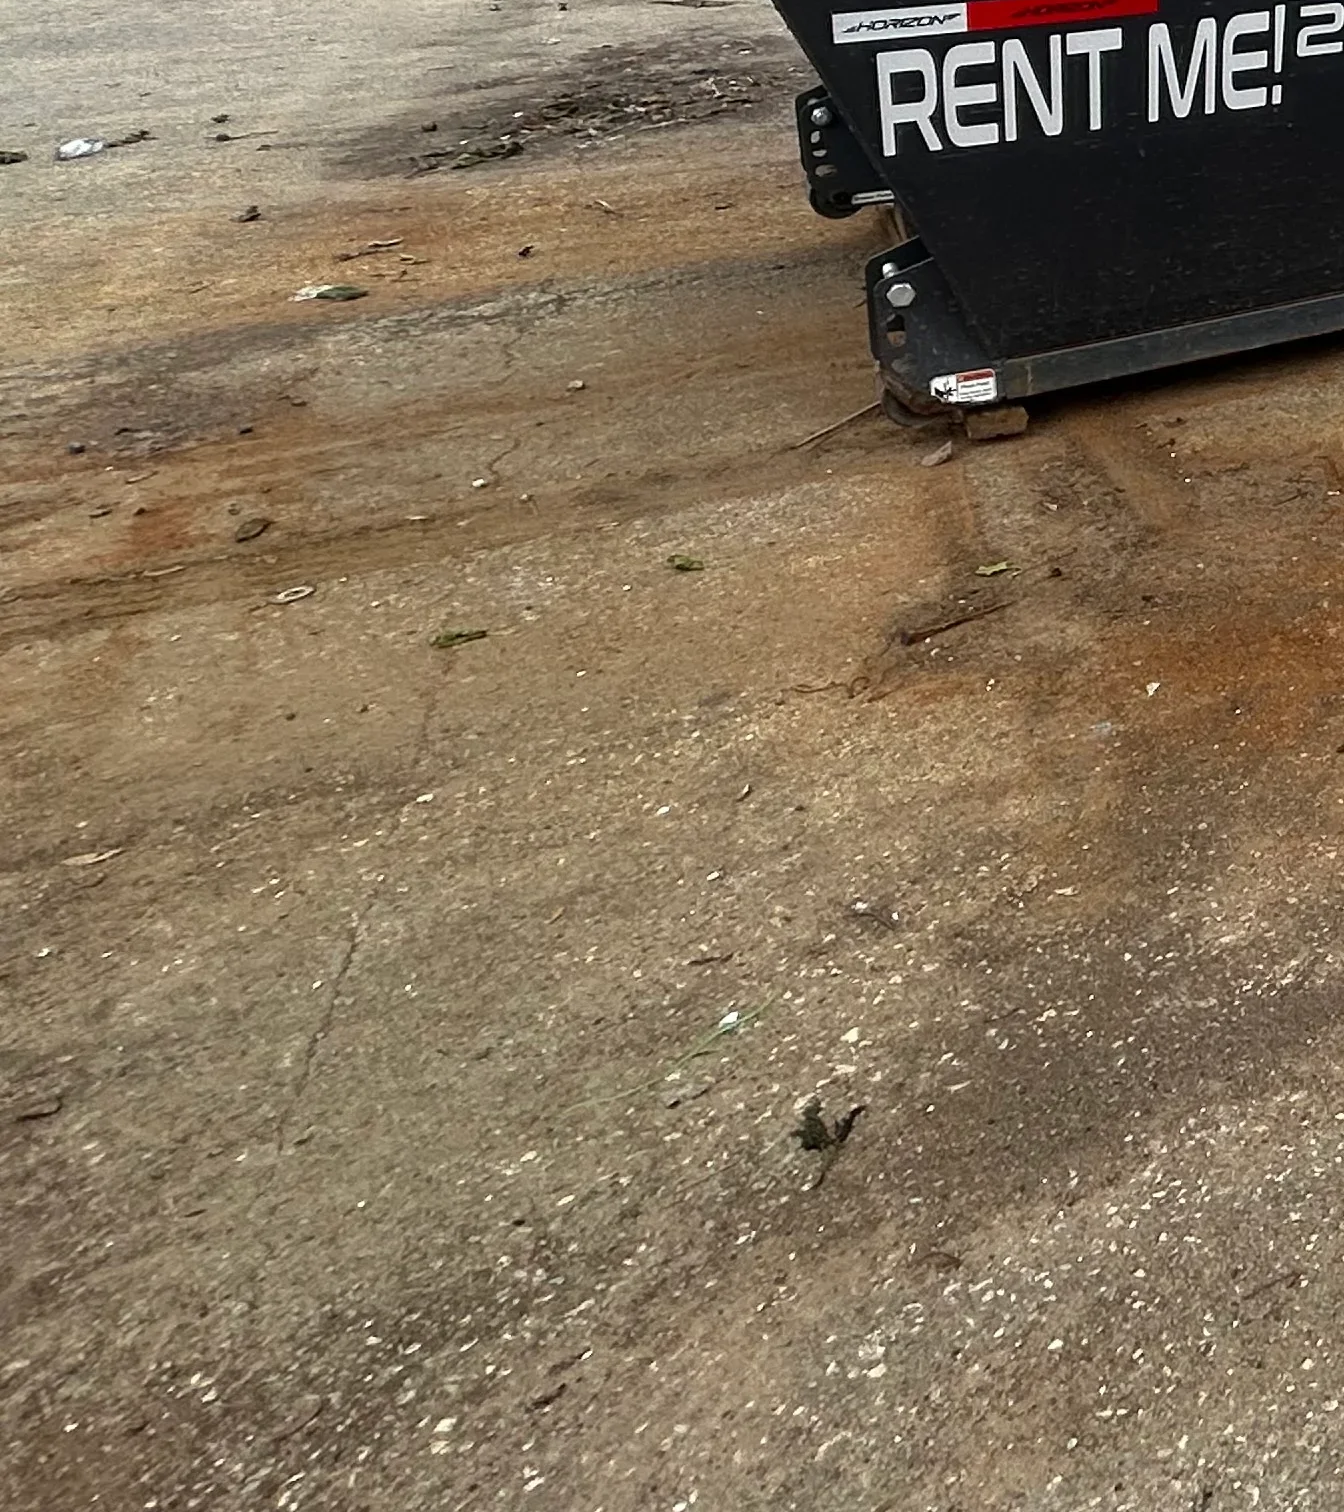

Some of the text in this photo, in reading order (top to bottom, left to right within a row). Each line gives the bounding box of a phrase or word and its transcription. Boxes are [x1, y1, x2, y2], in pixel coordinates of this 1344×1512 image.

[852, 14, 951, 33] HORIZON
[876, 4, 1286, 157] RENT ME!
